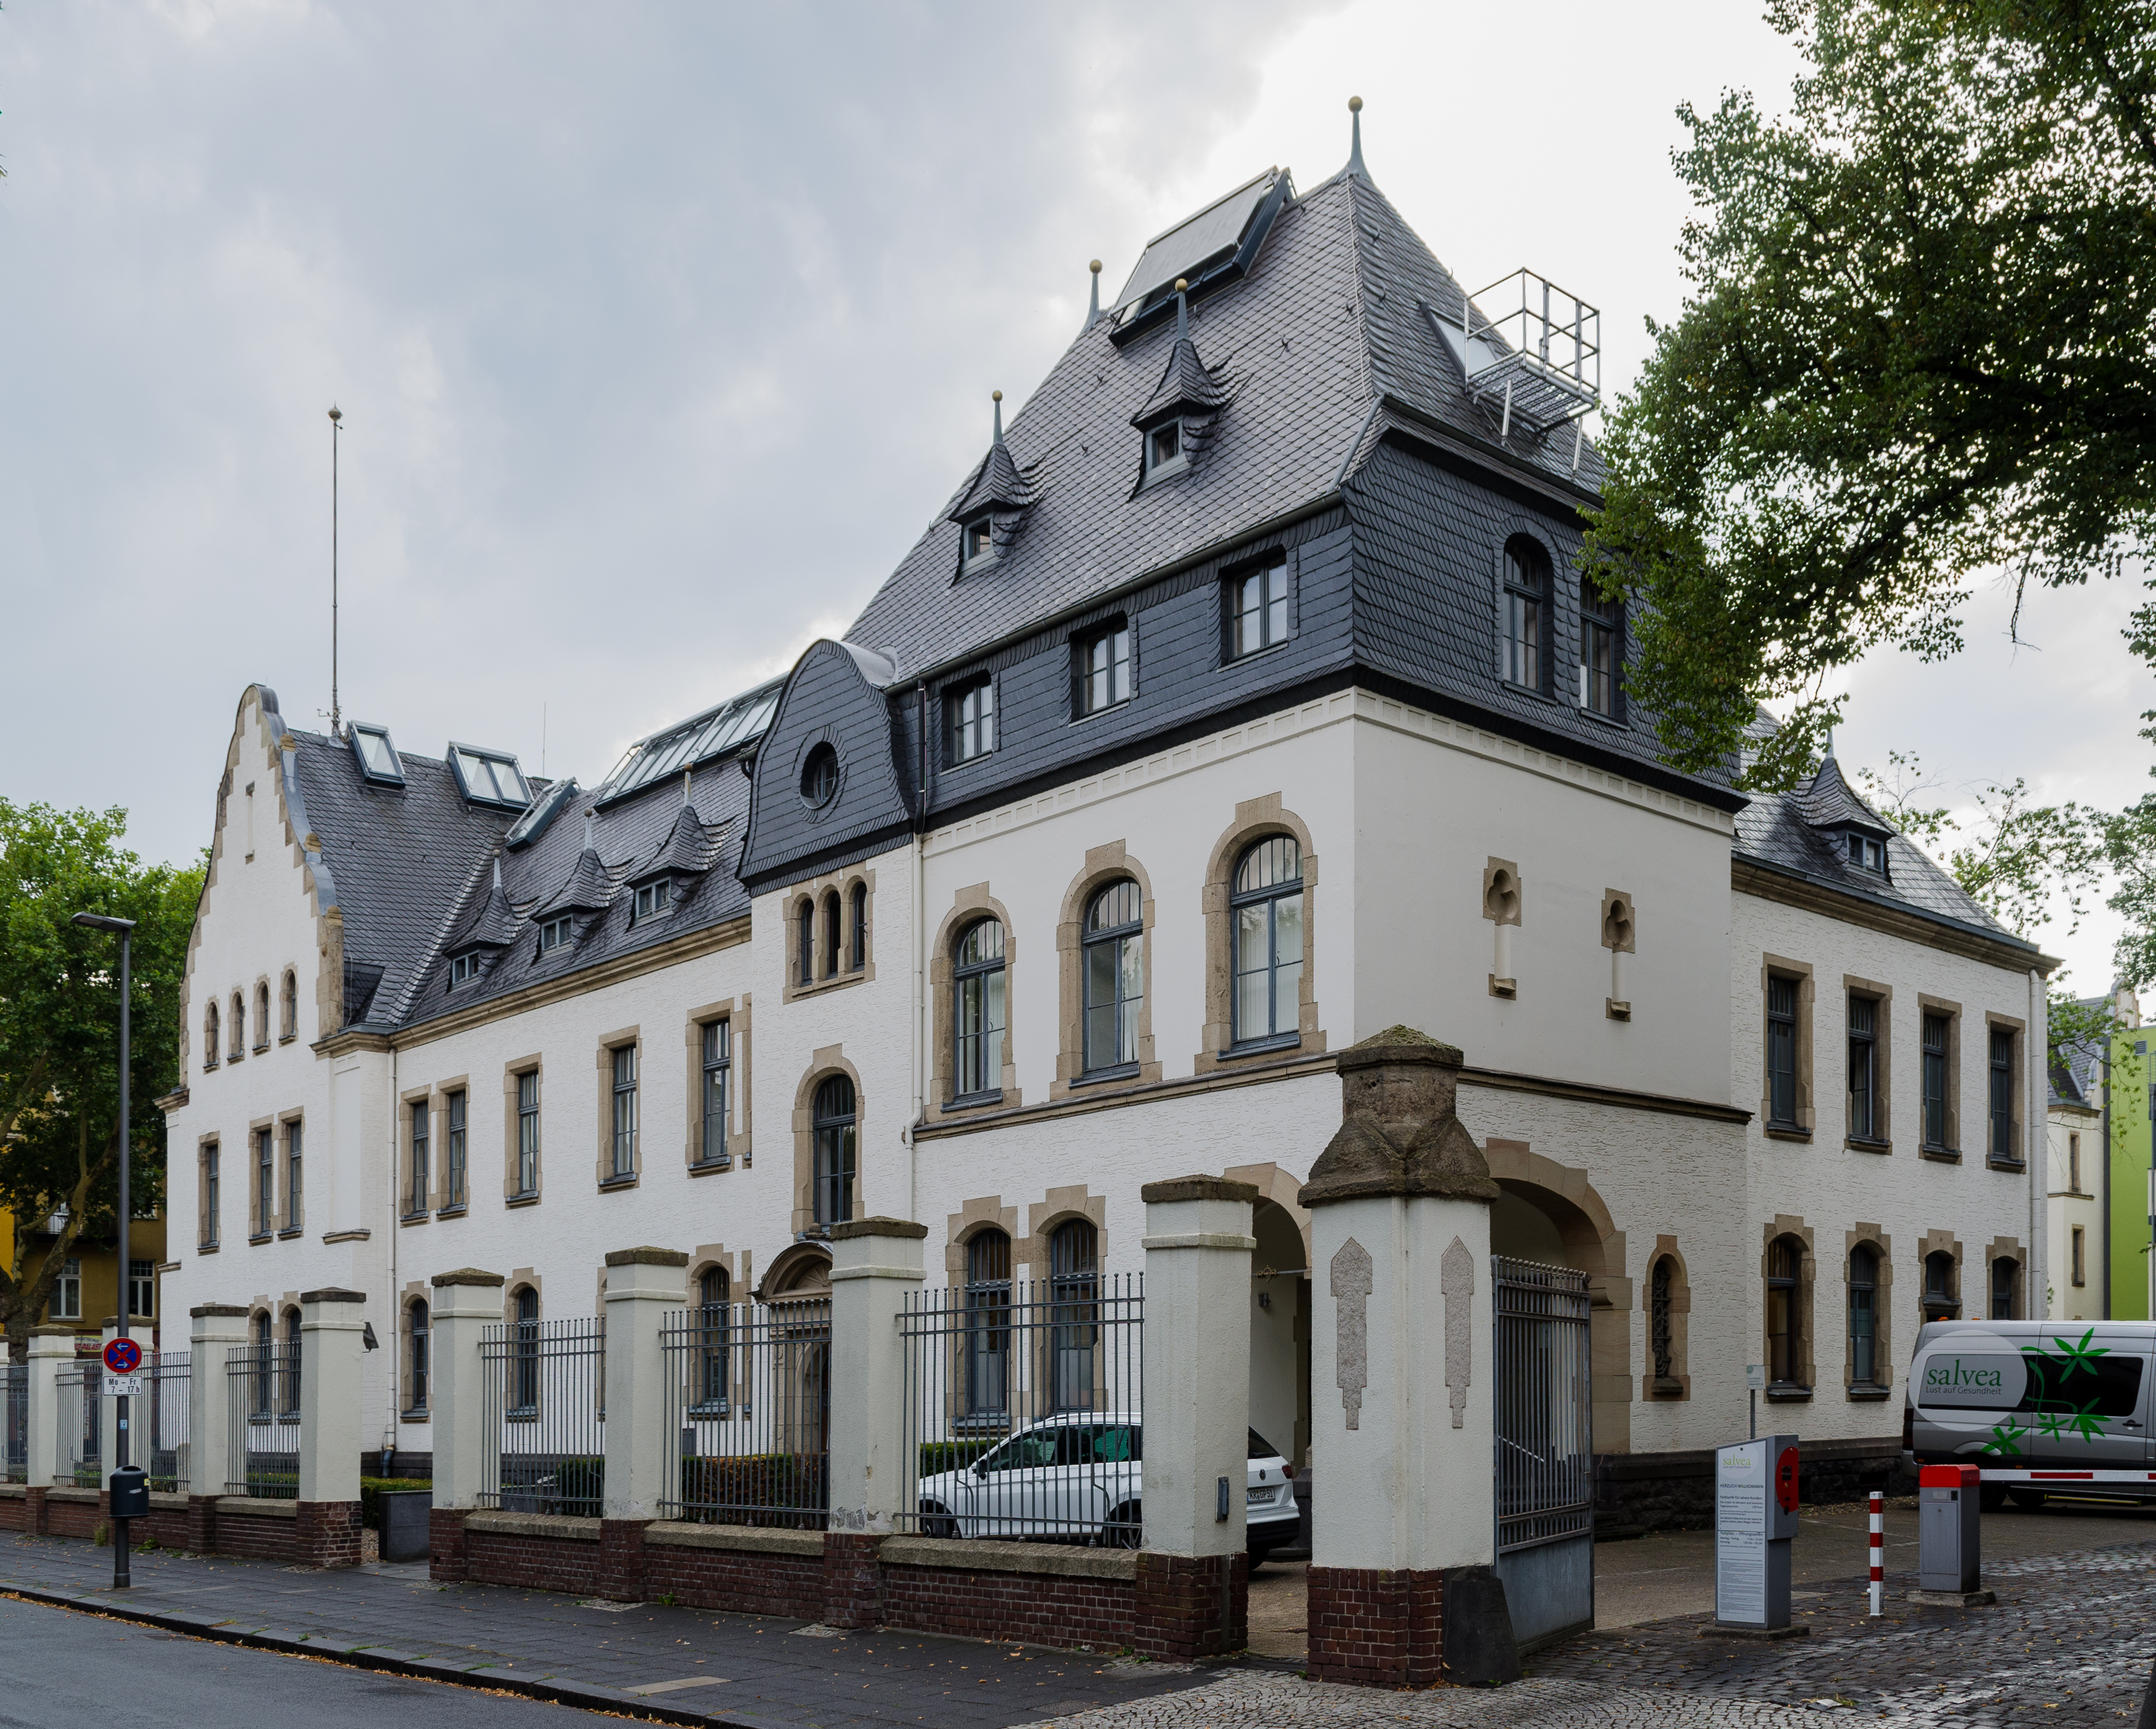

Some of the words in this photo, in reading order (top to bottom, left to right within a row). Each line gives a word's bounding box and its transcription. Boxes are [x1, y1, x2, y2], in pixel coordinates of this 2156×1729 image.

[1927, 1359, 2002, 1386] salvea
[1958, 1387, 2001, 1395] Gesundheit
[1723, 1454, 1751, 1465] salvea
